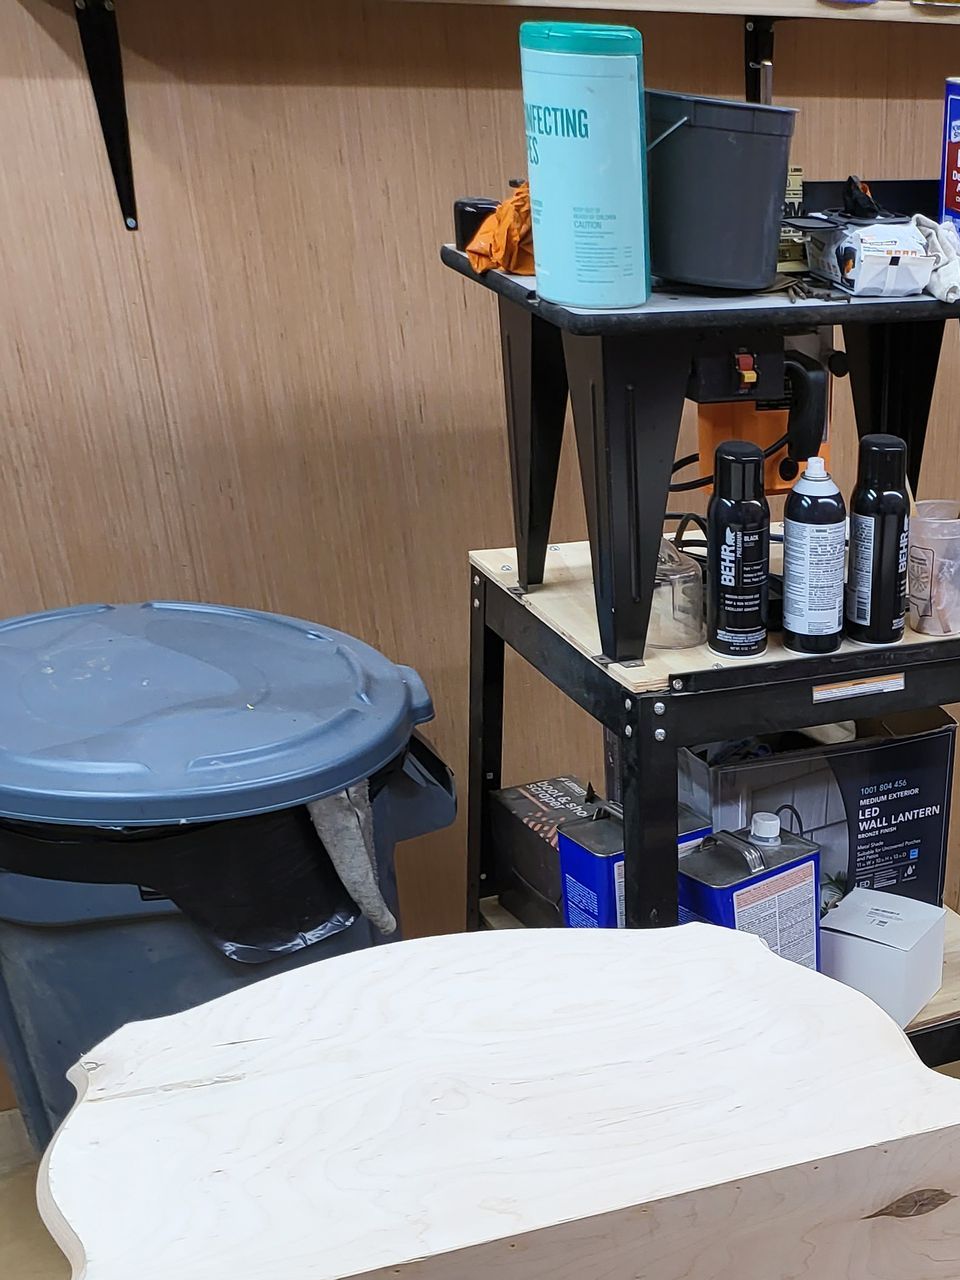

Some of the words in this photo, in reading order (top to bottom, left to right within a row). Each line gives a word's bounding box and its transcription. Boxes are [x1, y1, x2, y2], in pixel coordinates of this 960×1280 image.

[574, 221, 602, 229] CAUTION
[743, 534, 759, 542] BLACK
[898, 533, 909, 573] BEHR
[721, 545, 735, 586] BEHR
[525, 783, 566, 809] scraper
[861, 786, 877, 795] 1001
[879, 782, 892, 792] 804
[894, 779, 907, 788] 456
[537, 780, 564, 797] boot
[566, 802, 589, 818] sho
[859, 794, 887, 806] MEDIUM
[888, 788, 919, 800] EXTERIOR
[859, 807, 880, 819] LED
[859, 820, 888, 832] WALL
[891, 805, 940, 825] LANTERN
[858, 830, 879, 839] BRONZE
[879, 826, 897, 836] FINISH
